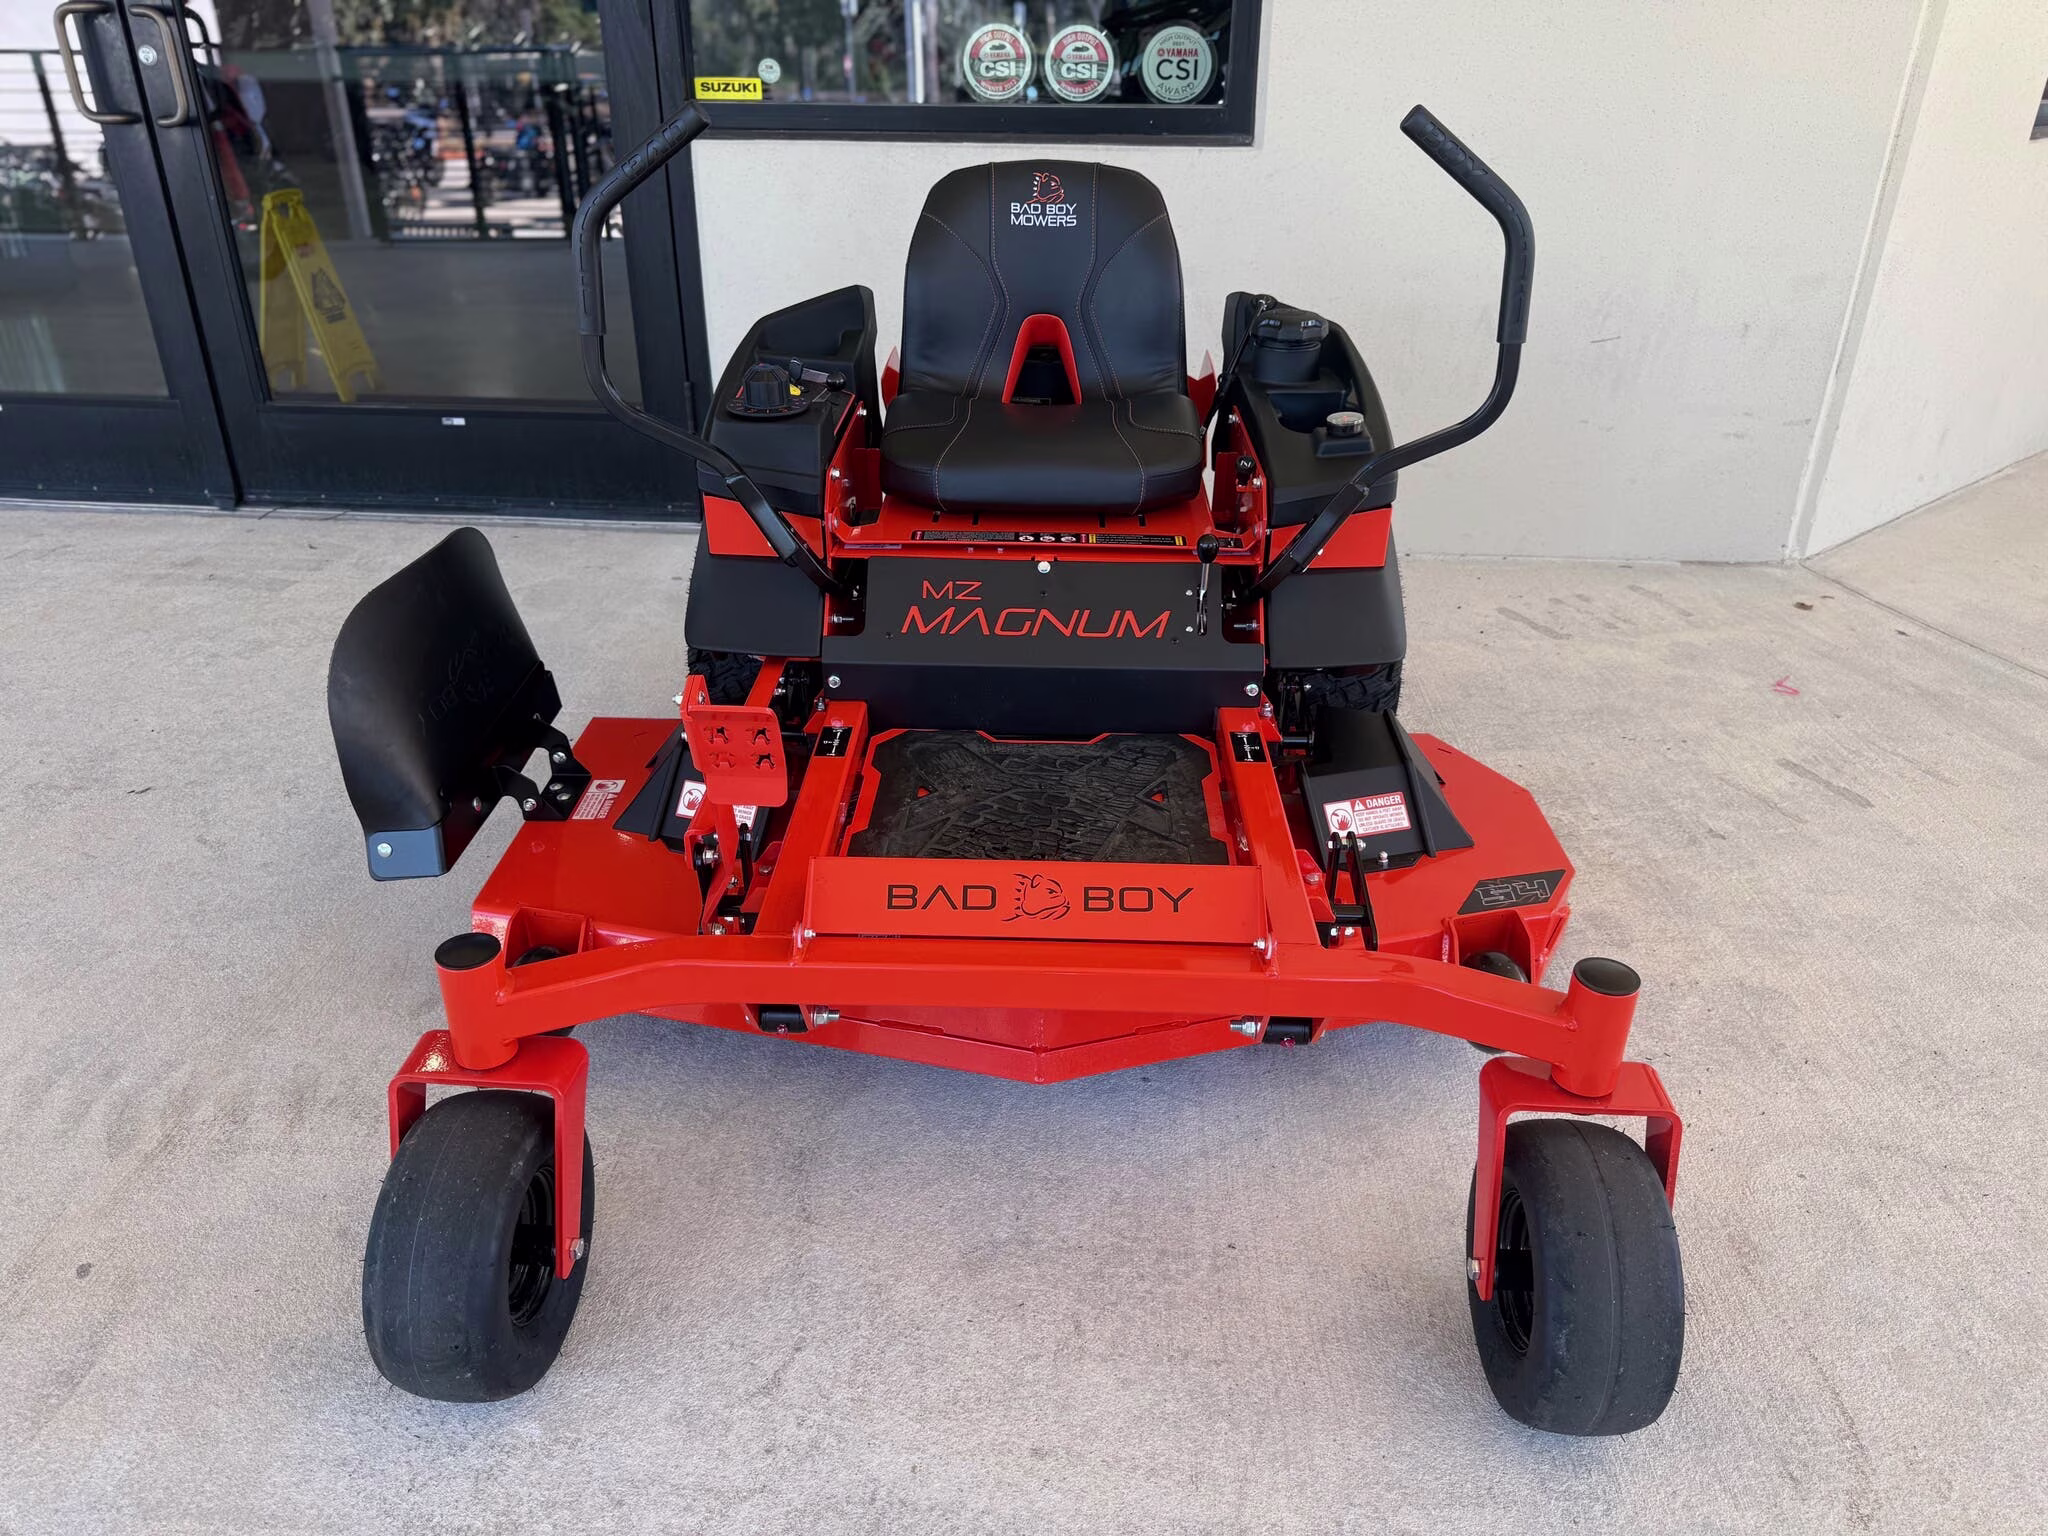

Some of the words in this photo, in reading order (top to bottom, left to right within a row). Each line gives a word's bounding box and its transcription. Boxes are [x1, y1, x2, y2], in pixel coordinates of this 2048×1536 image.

[1166, 48, 1199, 57] YAMAHA
[980, 61, 1016, 77] CSI
[1061, 63, 1098, 79] CSI
[1156, 58, 1198, 80] CSI
[700, 82, 757, 93] SUZUKI
[1157, 82, 1195, 95] AWARD
[1010, 202, 1041, 214] BAD
[1046, 203, 1077, 214] BOY
[1010, 213, 1077, 227] MOWERS
[921, 580, 983, 600] MZ
[901, 605, 1172, 639] MAGNUM
[1365, 795, 1402, 808] DANGER
[887, 884, 997, 910] BAD
[1083, 886, 1194, 912] BOY
